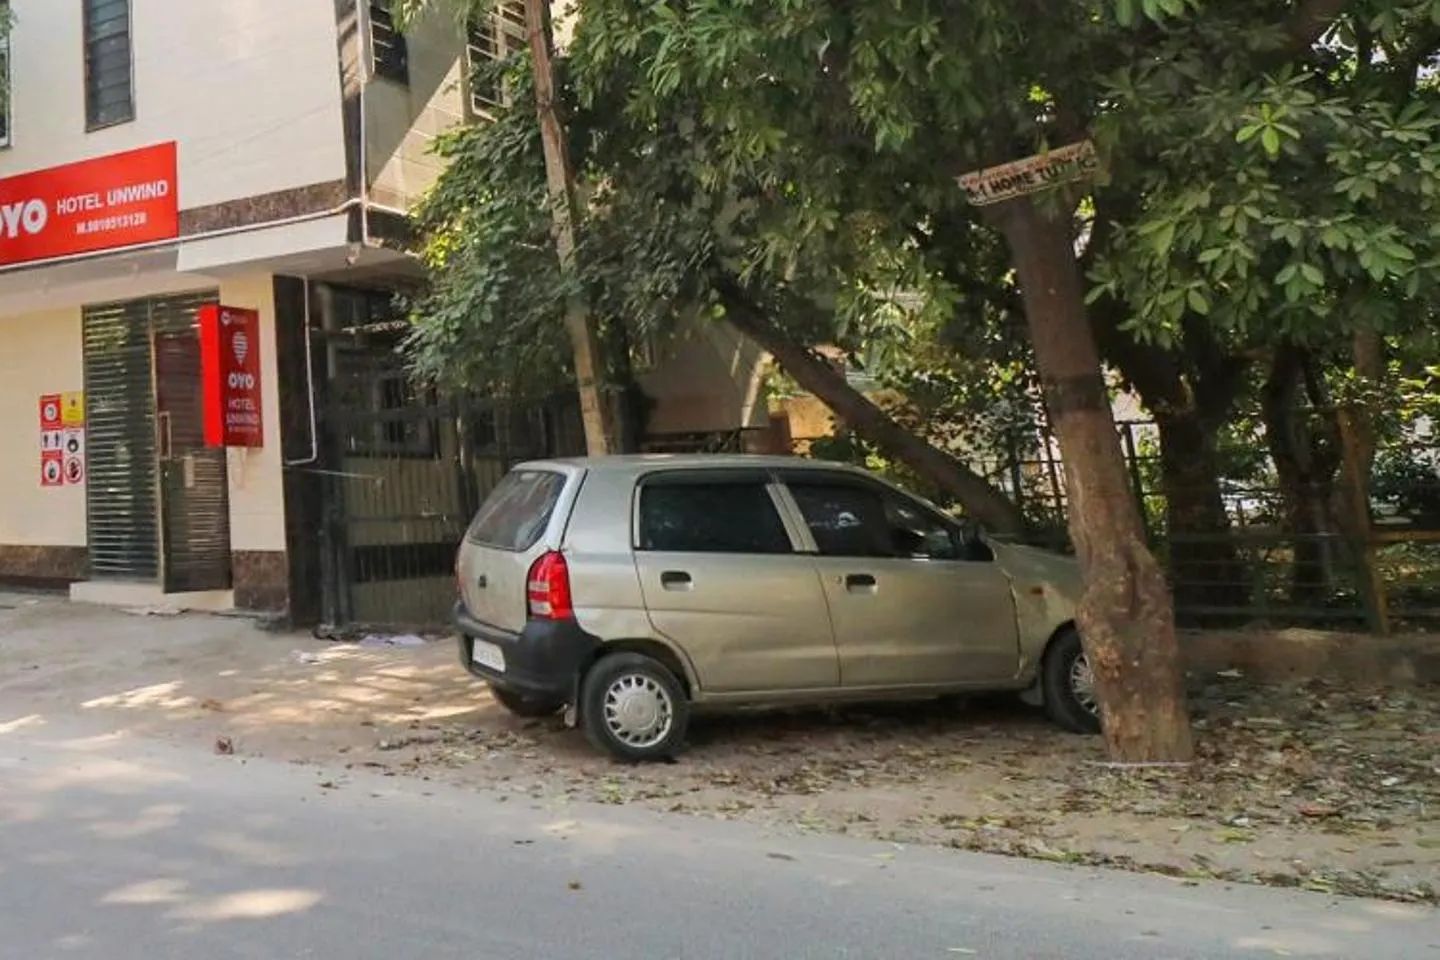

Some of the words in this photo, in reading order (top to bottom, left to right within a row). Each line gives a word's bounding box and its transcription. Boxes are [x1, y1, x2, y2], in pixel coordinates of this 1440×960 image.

[990, 171, 1035, 193] HOME
[57, 193, 104, 215] HOTEL
[107, 180, 168, 206] UNWIND
[228, 373, 254, 389] OYO
[228, 398, 255, 410] HOTEL
